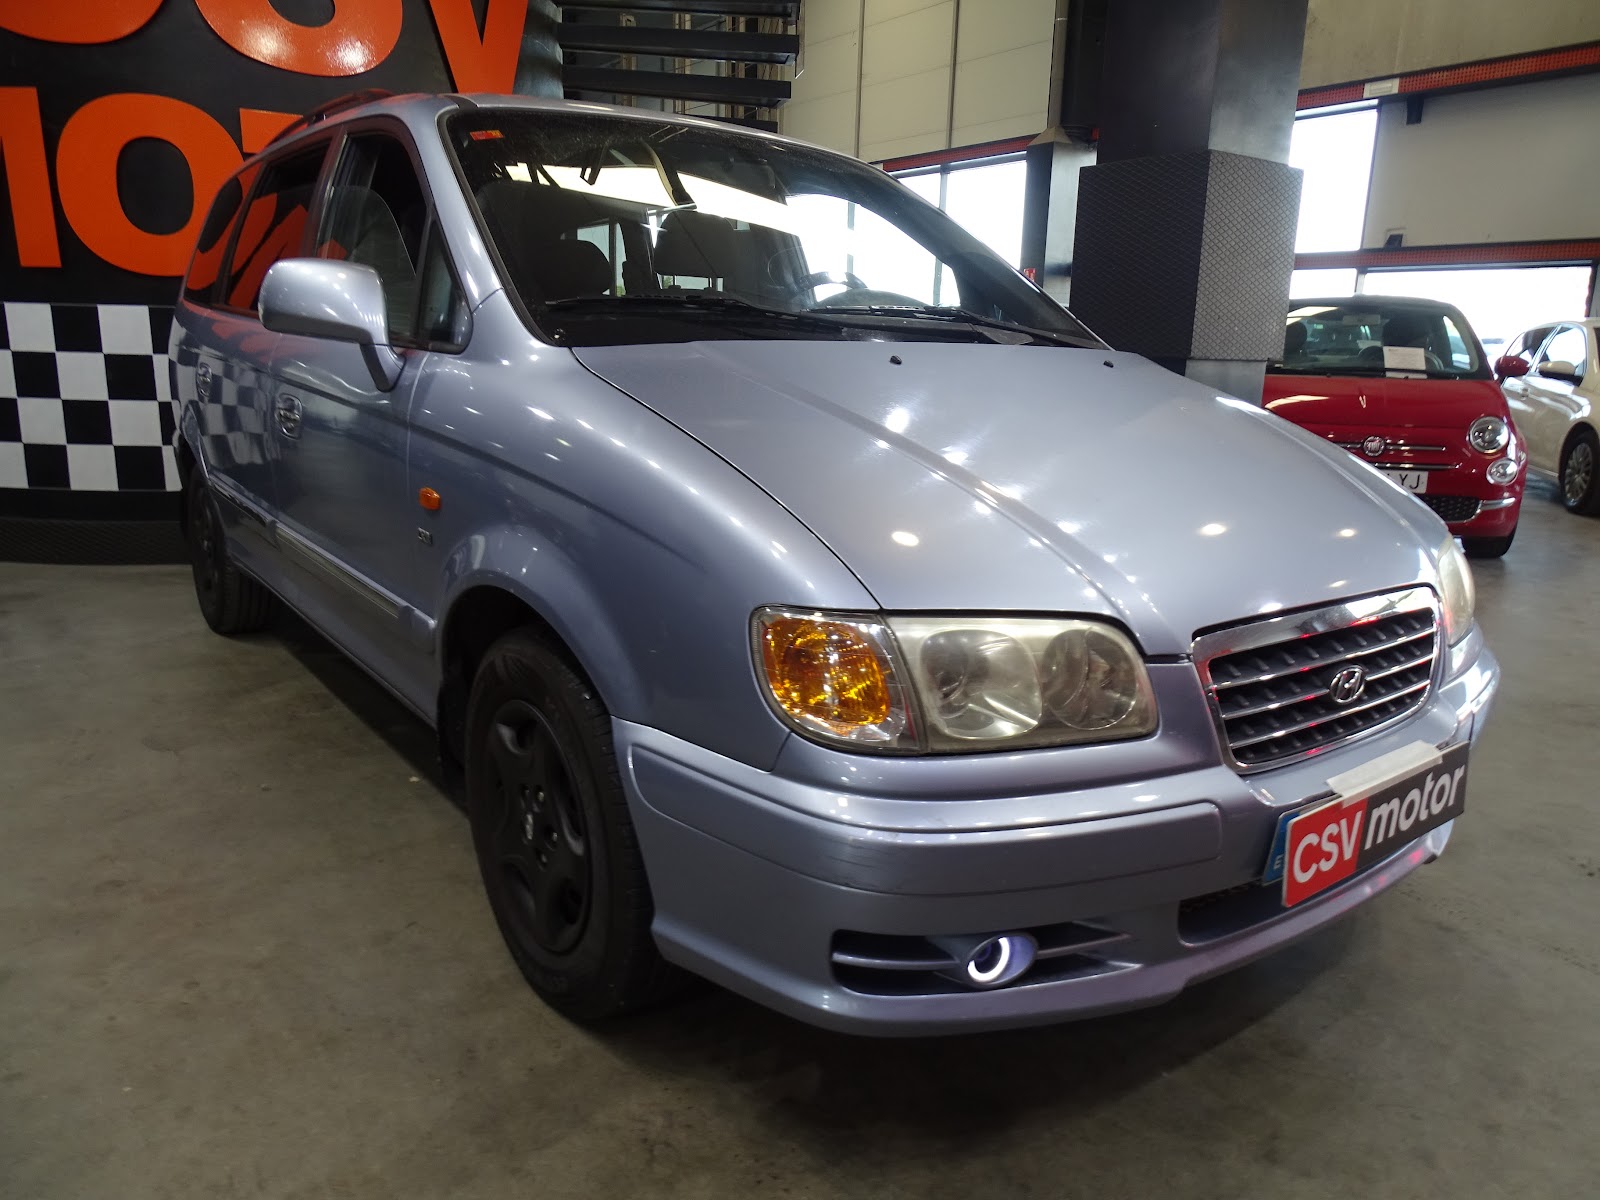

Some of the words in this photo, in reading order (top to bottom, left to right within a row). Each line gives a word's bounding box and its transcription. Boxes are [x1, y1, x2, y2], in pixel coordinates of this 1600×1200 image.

[1386, 473, 1421, 490] YJ
[1292, 810, 1363, 883] CSV
[1364, 764, 1466, 851] motor
